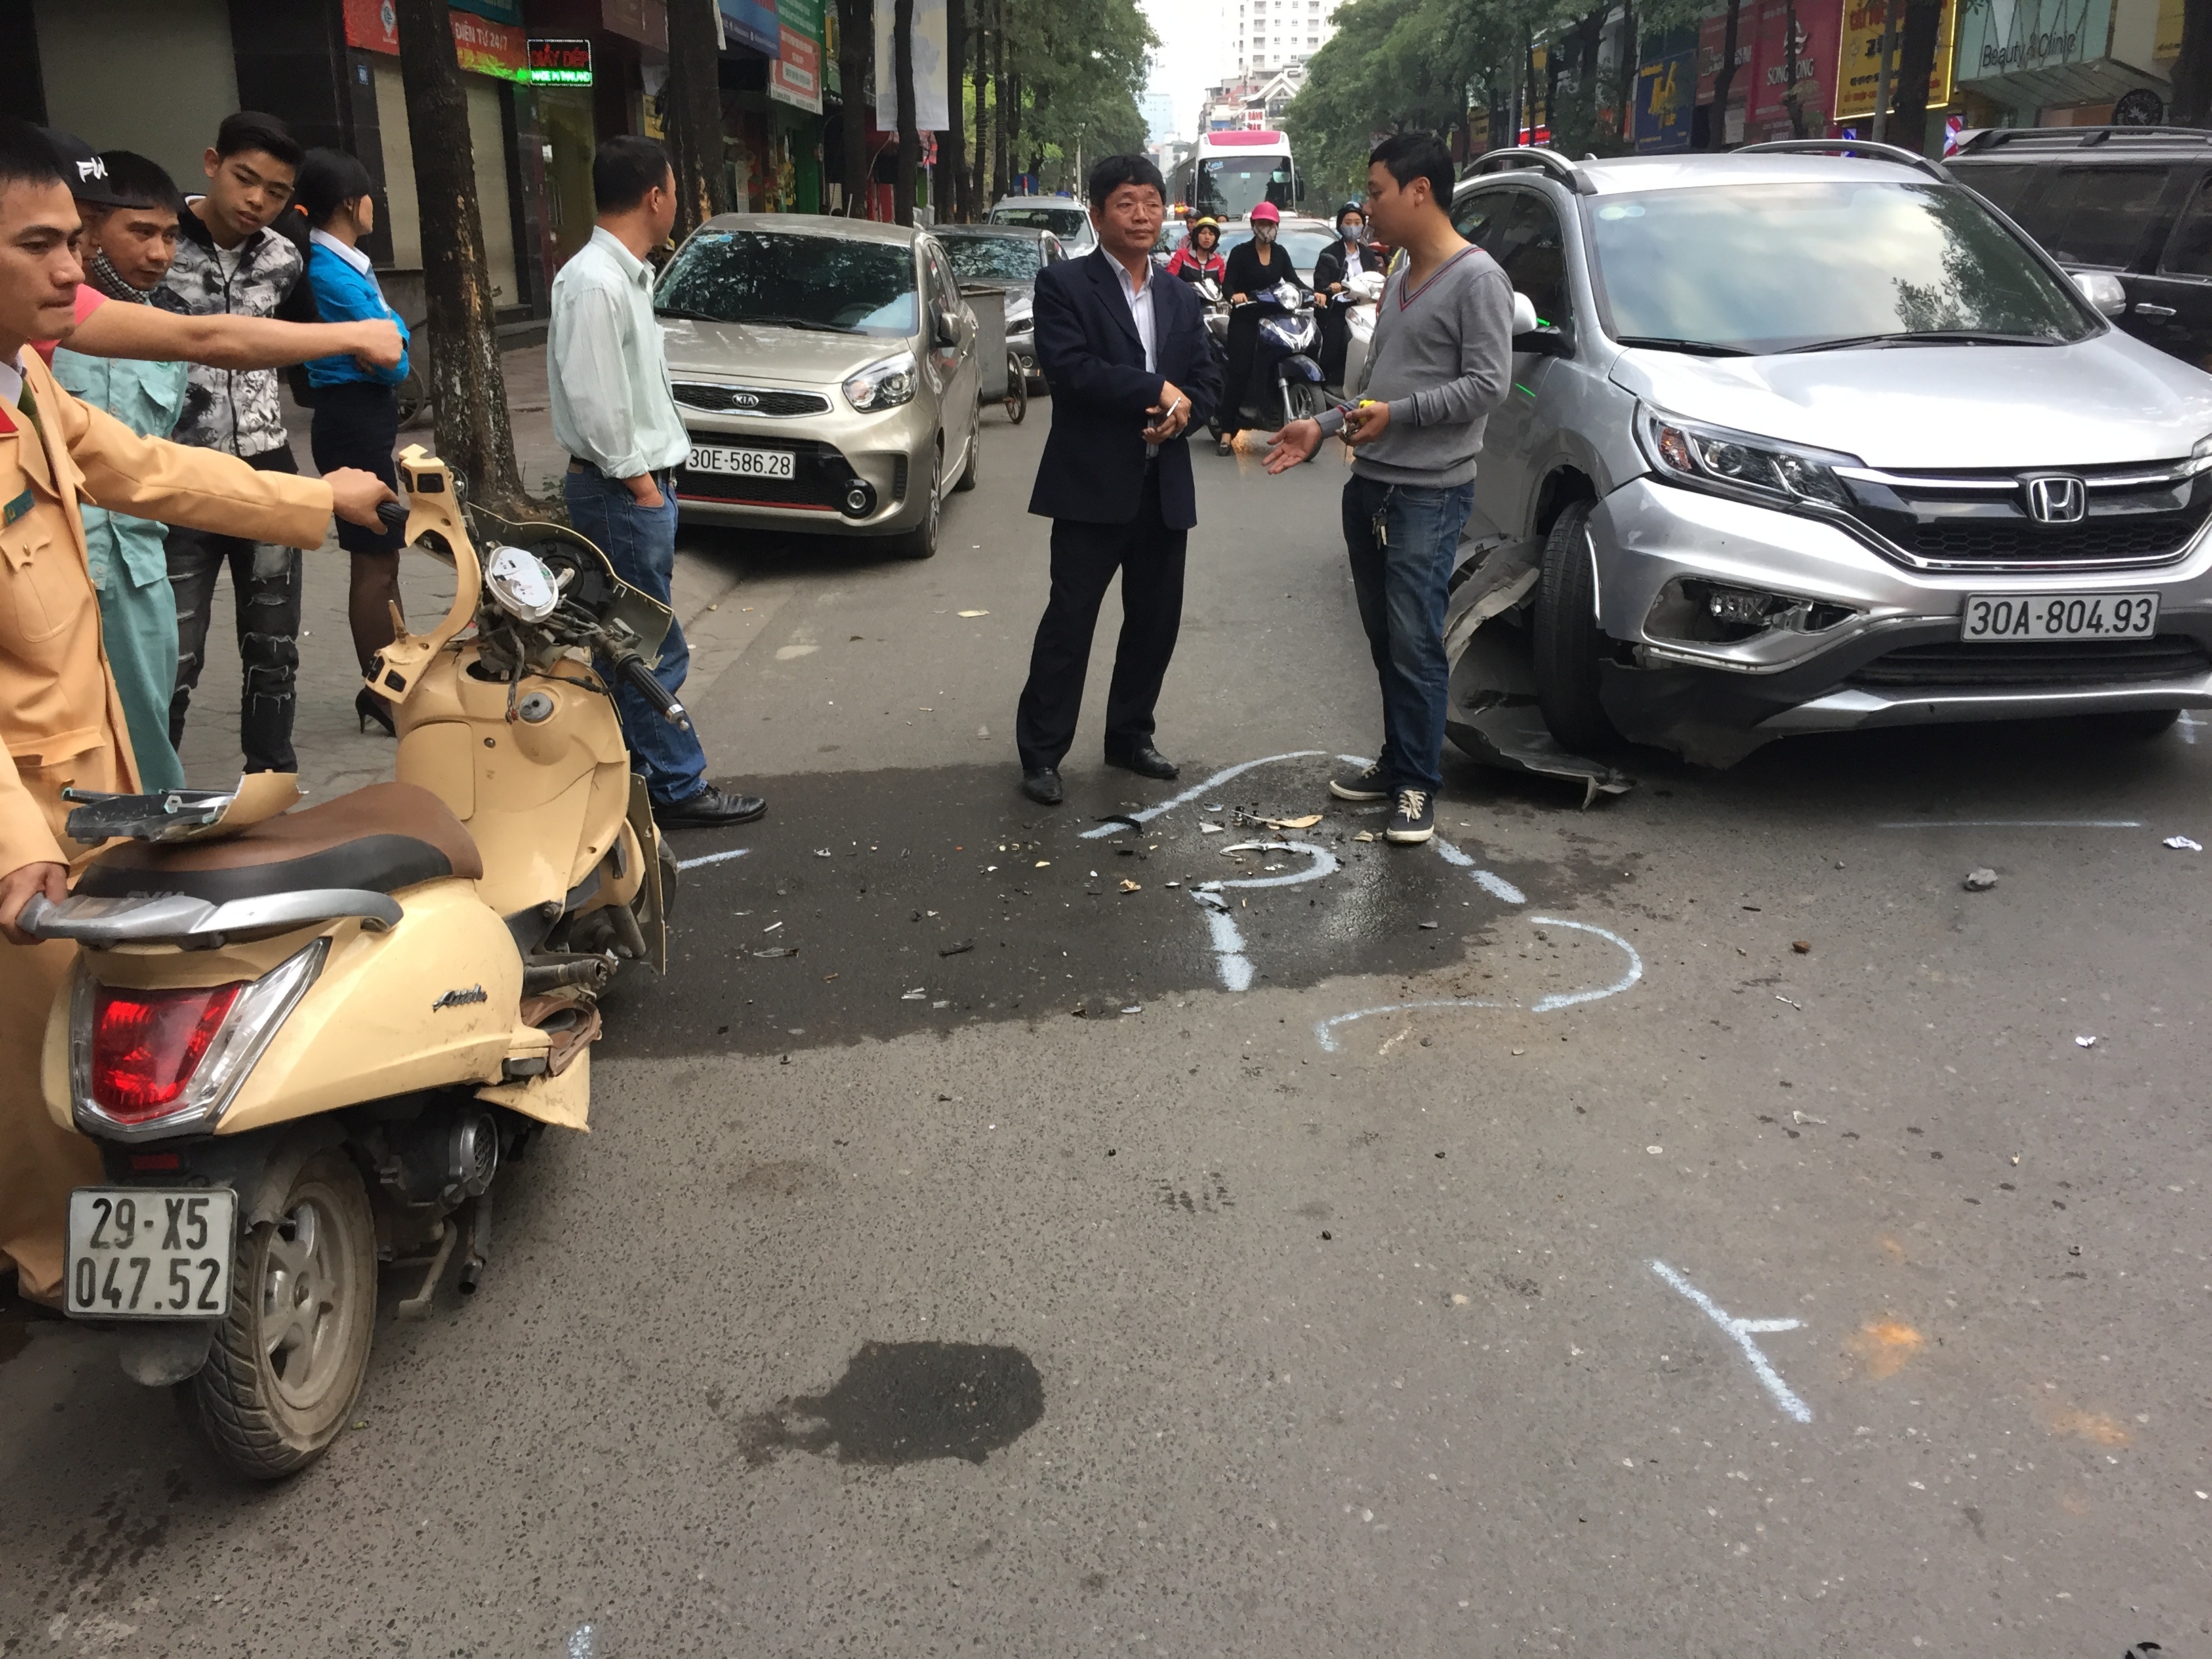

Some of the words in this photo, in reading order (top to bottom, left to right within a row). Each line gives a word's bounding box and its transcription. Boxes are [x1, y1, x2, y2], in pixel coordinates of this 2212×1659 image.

[1982, 41, 2025, 67] Beauty
[2039, 31, 2078, 58] Clinic
[1767, 64, 1789, 85] SONG
[1794, 58, 1814, 79] ONG
[689, 448, 791, 476] 30E-586.28
[1970, 598, 2153, 636] 30A-804.93
[89, 1197, 210, 1250] 29-X5
[75, 1256, 221, 1311] 047.52
